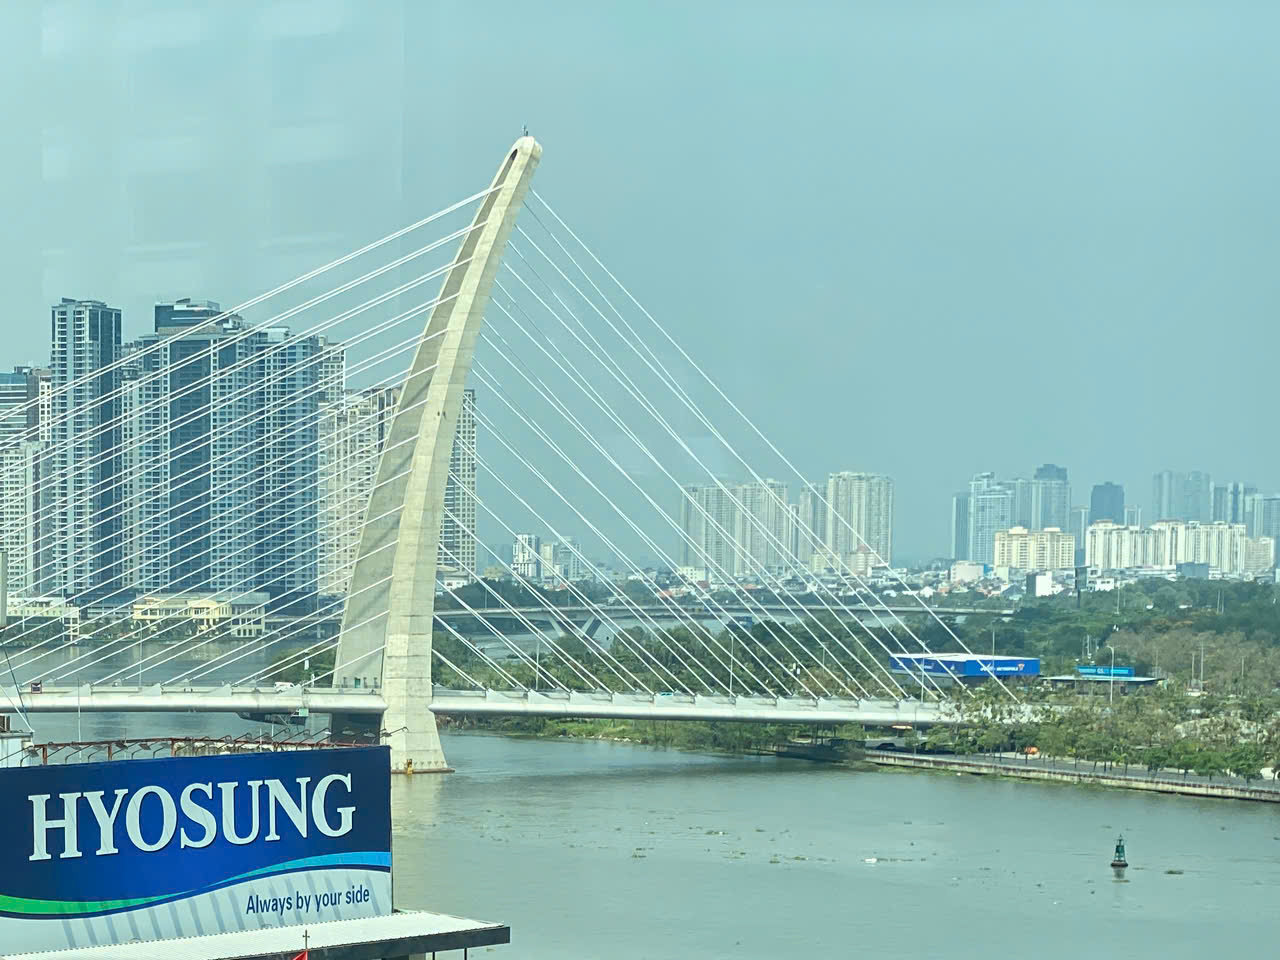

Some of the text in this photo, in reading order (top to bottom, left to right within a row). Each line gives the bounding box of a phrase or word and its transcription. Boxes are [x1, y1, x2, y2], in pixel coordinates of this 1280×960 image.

[28, 773, 356, 861] HYOSUNG
[246, 884, 370, 916] Always by your side
